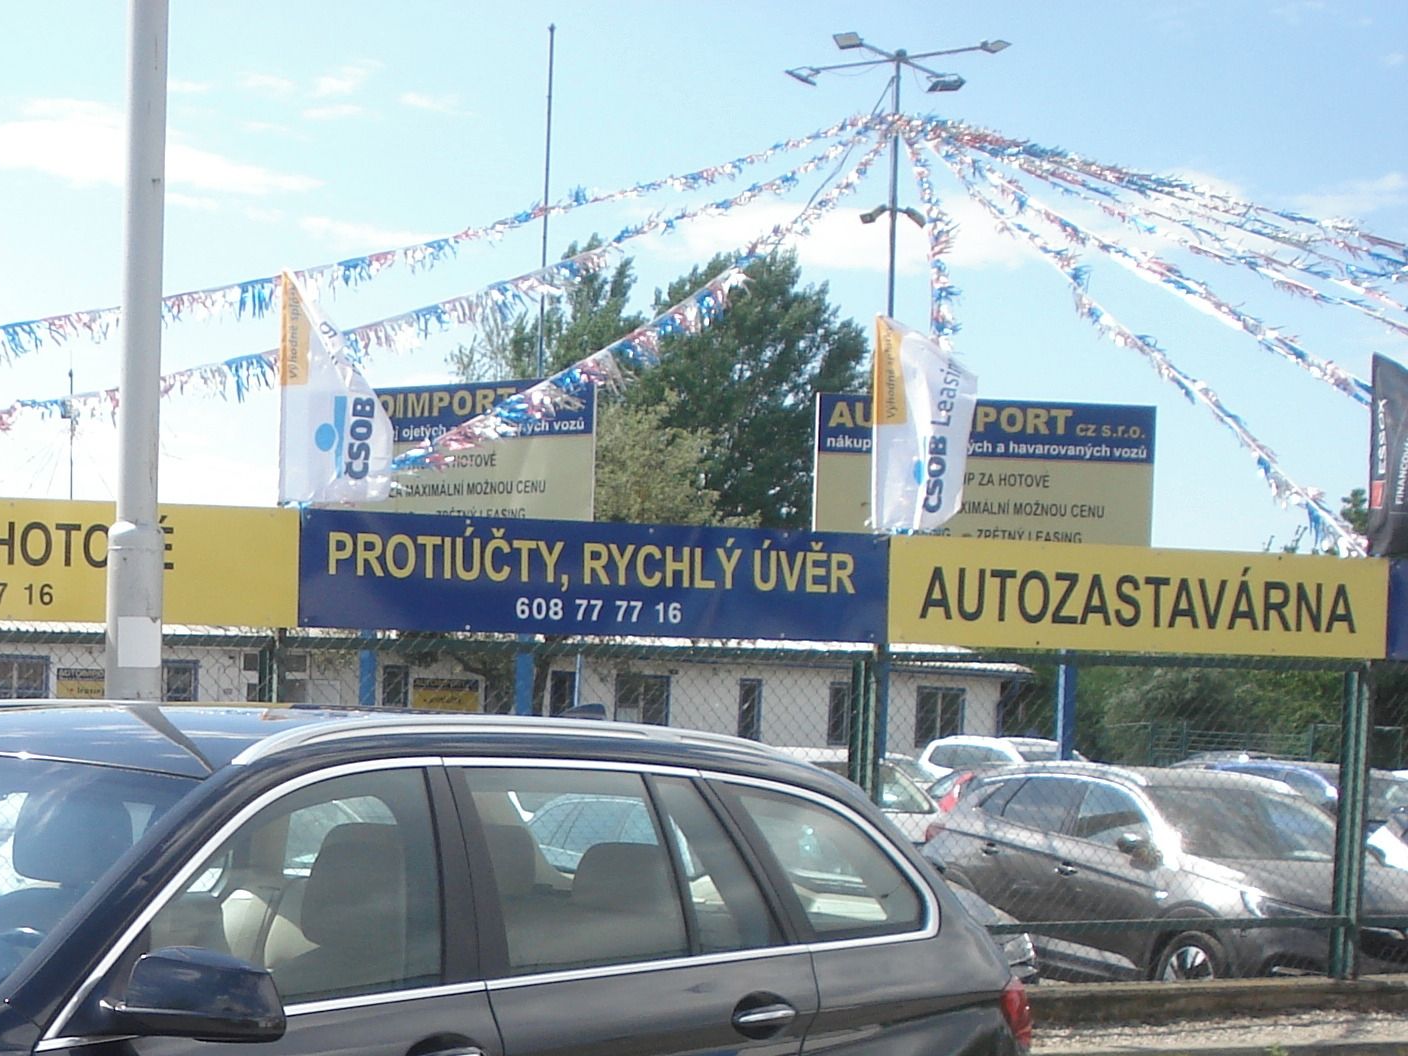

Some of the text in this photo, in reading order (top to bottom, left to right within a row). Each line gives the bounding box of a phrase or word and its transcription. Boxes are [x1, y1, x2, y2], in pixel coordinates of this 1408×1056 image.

[553, 416, 584, 431] vozů
[1076, 424, 1095, 437] cz
[1101, 424, 1146, 438] s.r.o.
[344, 396, 376, 481] ČSOB
[826, 434, 872, 452] nákup
[1009, 440, 1110, 459] havarovaných
[1114, 444, 1147, 459] vozů
[467, 478, 513, 496] MOŽNOU
[517, 479, 546, 494] CENU
[978, 472, 994, 487] ZA
[998, 470, 1050, 489] HOTOVÉ
[960, 498, 1105, 519] XIMÁLNÍ MOŽNOU CENU
[327, 526, 856, 595] PROTIÚČTY, RYCHLÝ ÚVĚR
[23, 582, 54, 607] 16
[919, 566, 1357, 635] AUTOZASTAVÁRNA
[515, 596, 683, 624] 608 77 77 16
